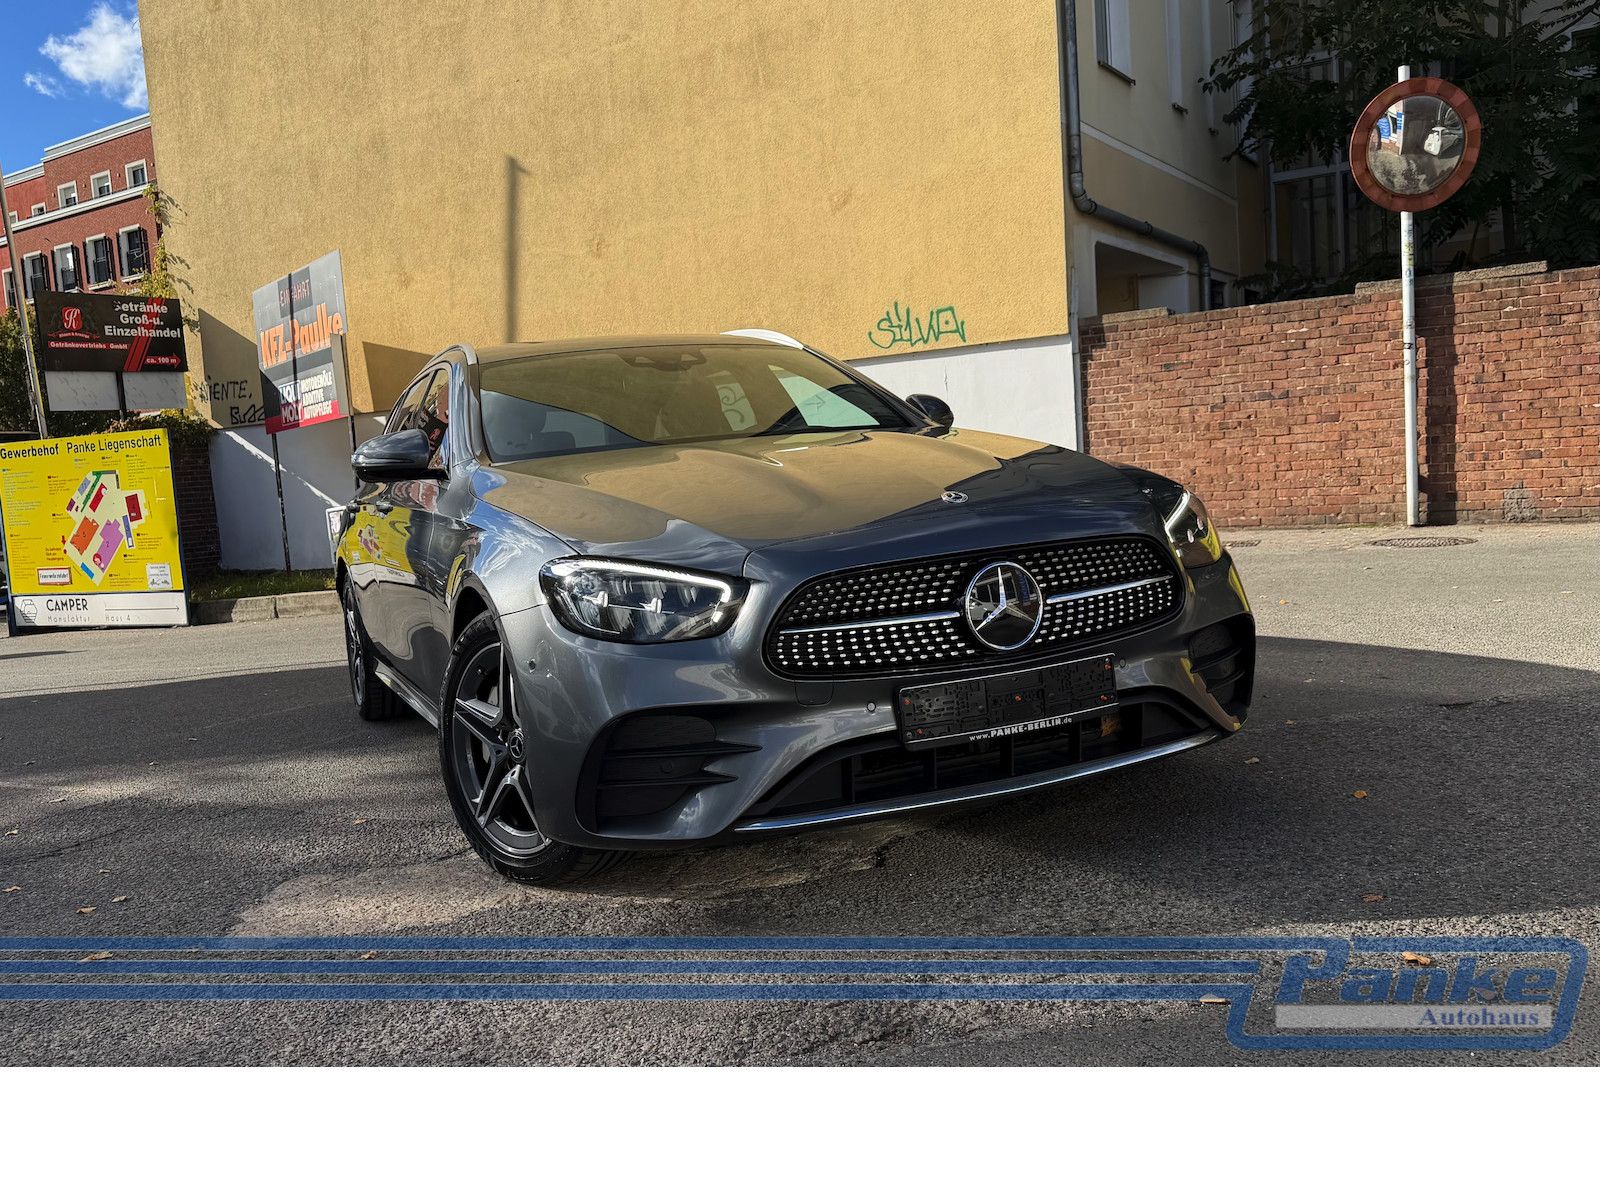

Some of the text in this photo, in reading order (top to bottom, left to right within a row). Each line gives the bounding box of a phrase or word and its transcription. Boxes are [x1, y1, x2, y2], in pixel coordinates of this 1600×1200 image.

[279, 279, 310, 307] EINAHRT
[104, 325, 181, 338] Einzelhandel
[260, 302, 343, 369] KFZ-Paulke
[281, 402, 303, 423] MOLY
[0, 434, 162, 460] Gewerbehof Panke Liegenschaft
[46, 598, 89, 613] CAMPER
[47, 615, 90, 623] Manufaktur
[105, 615, 123, 623] Haus
[969, 716, 1073, 741] www.PANKE-BERLIN.de
